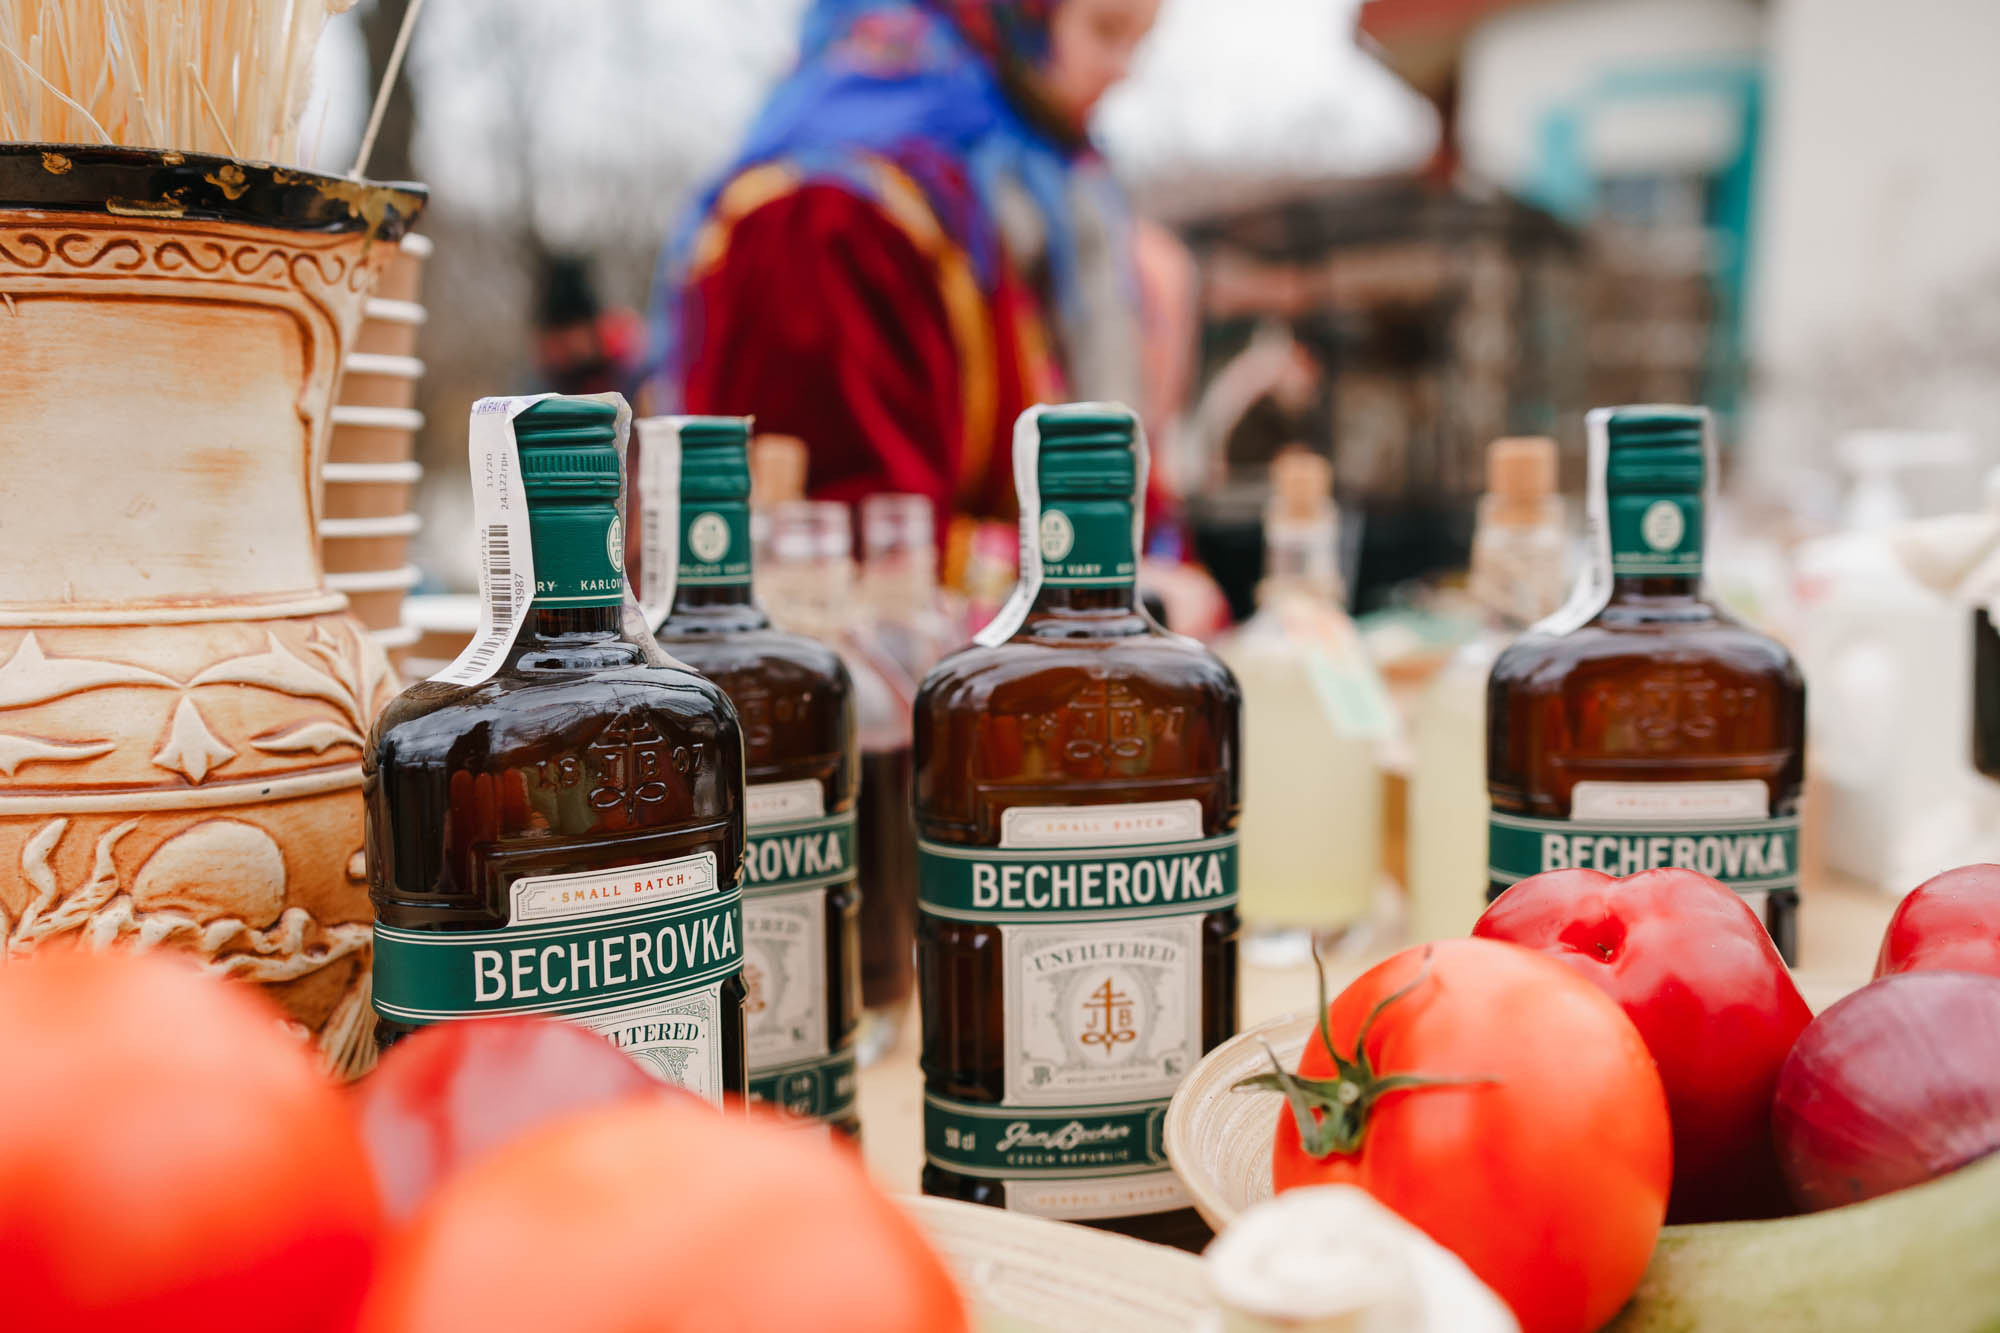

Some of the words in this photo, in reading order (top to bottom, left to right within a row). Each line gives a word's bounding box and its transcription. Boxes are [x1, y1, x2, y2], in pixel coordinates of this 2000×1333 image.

[486, 453, 494, 488] 11/20
[561, 885, 622, 904] SMALL
[634, 873, 685, 893] BATCH
[972, 852, 1226, 909] BECHEROVKA
[472, 910, 738, 1003] BECHEROVKA
[1033, 942, 1177, 972] UNFILTERED
